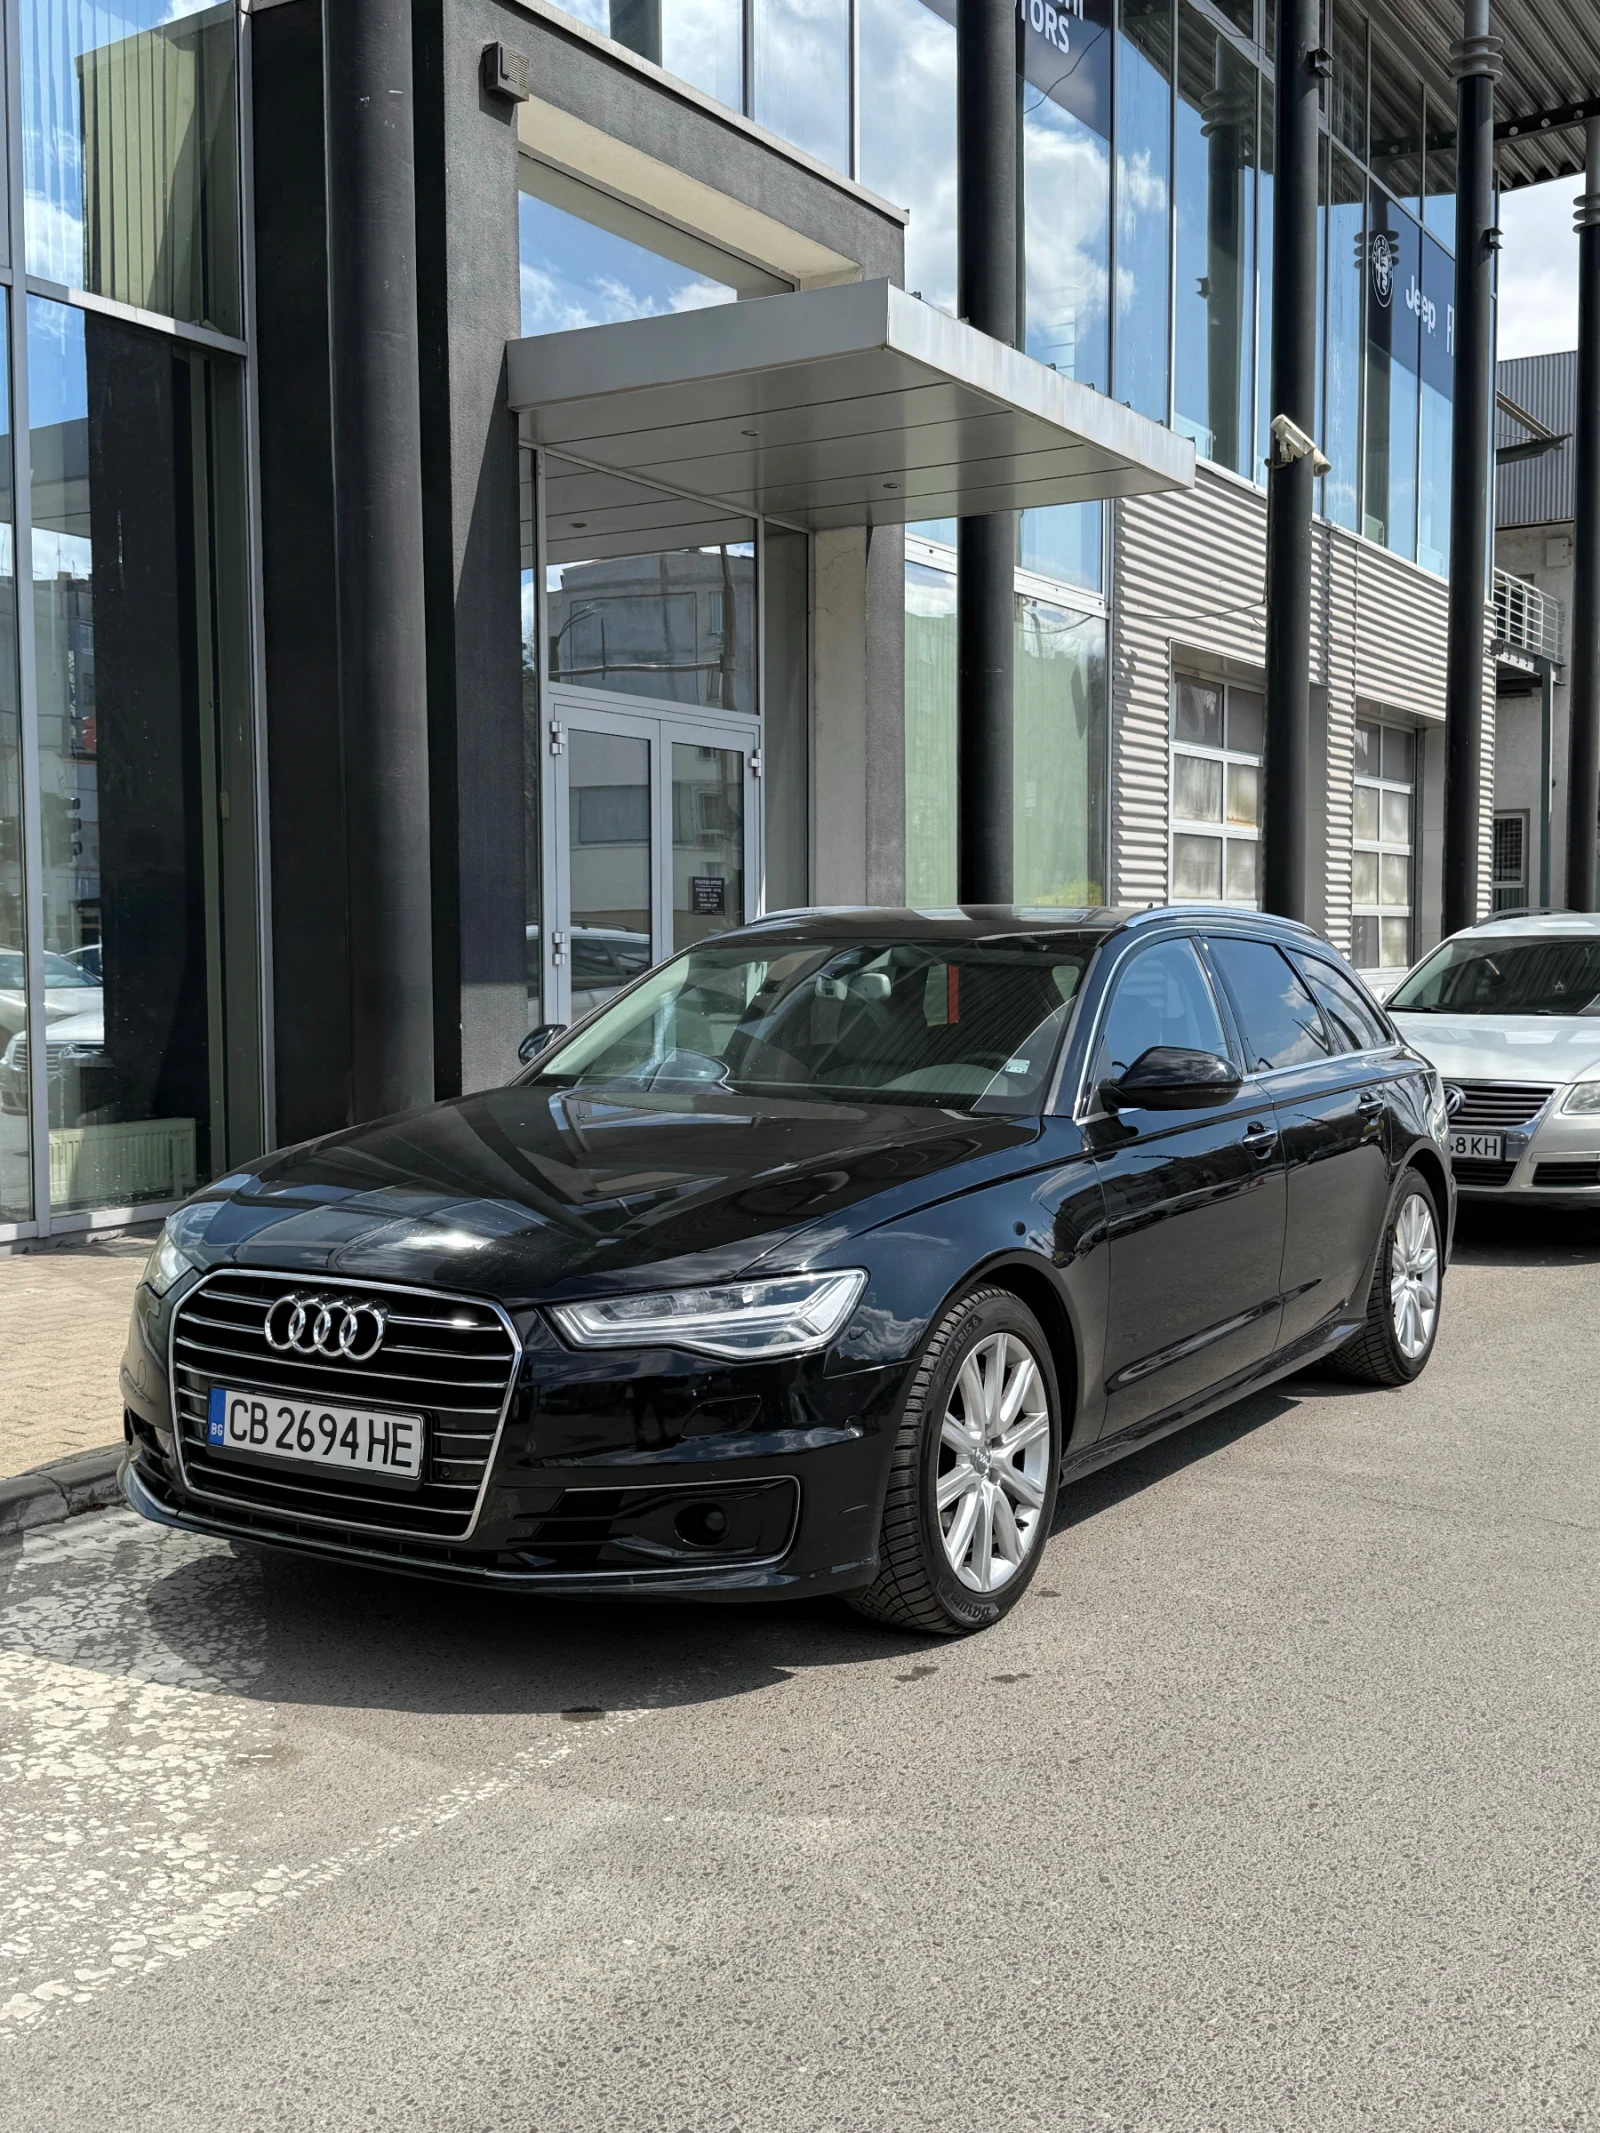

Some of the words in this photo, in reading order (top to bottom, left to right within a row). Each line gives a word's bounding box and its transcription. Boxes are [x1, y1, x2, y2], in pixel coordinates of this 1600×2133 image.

[1405, 275, 1436, 333] Jeep
[1471, 1137, 1497, 1156] KH
[941, 1323, 973, 1374] POLARIS
[211, 1423, 223, 1436] BG
[276, 1407, 359, 1460] 2694
